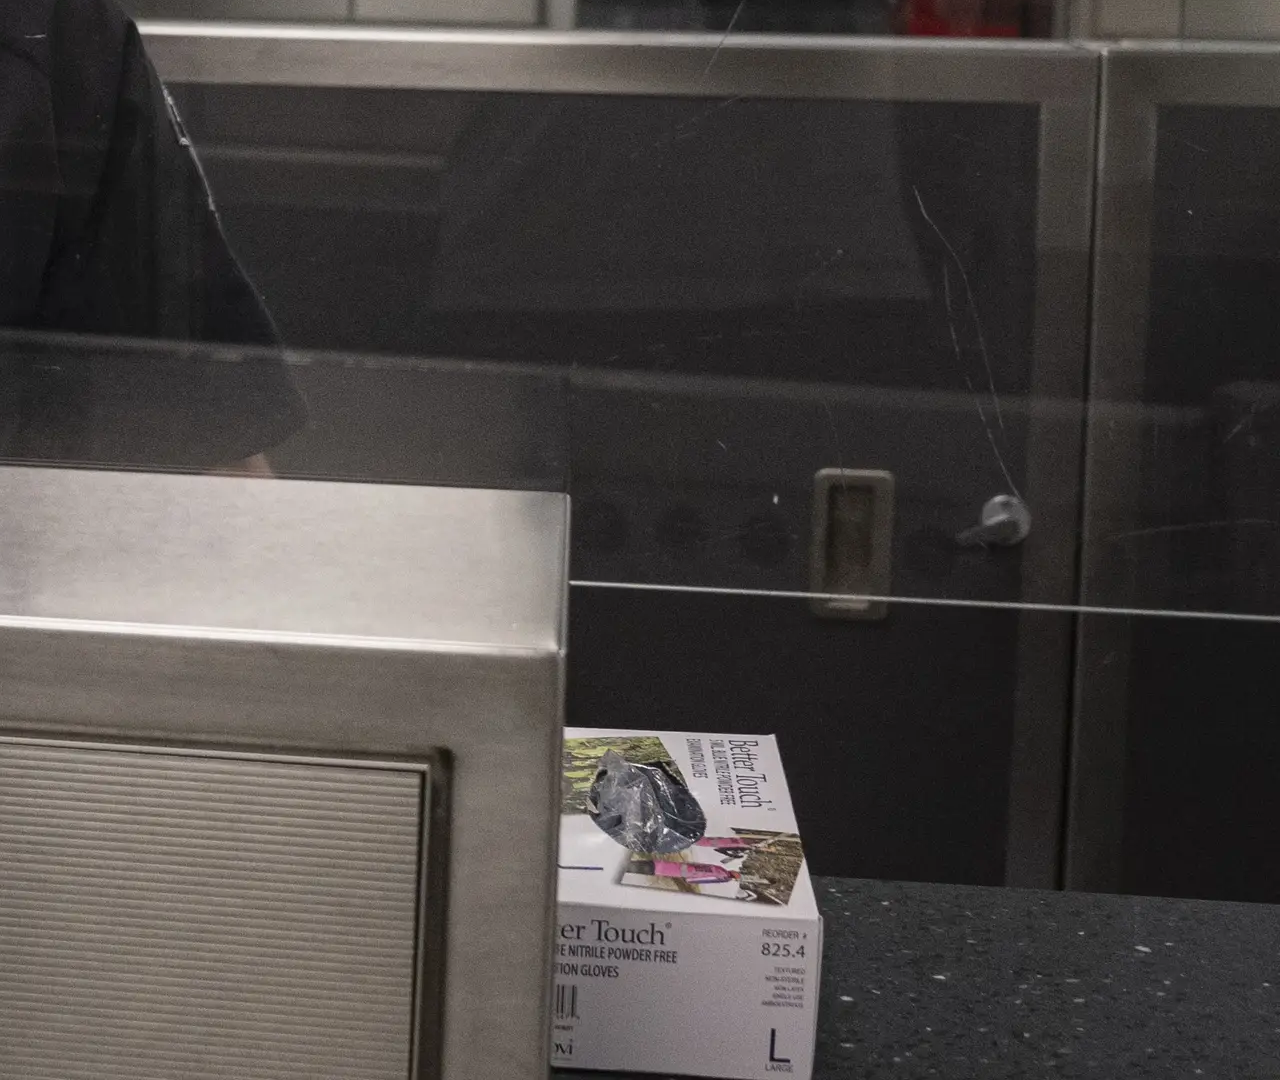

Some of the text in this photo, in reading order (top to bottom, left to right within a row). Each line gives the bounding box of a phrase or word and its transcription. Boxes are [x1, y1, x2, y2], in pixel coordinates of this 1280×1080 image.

[728, 740, 773, 809] Better Touch
[716, 773, 733, 794] POWDER
[720, 793, 736, 805] FREE
[591, 919, 665, 945] Touch
[762, 929, 799, 940] REORDER
[568, 945, 606, 959] NITRILE
[608, 947, 652, 962] POWDER
[654, 951, 678, 963] FREE
[761, 942, 805, 958] 825.4
[580, 964, 620, 978] GLOVES
[769, 1027, 791, 1063] L
[765, 1064, 794, 1073] LARGE
